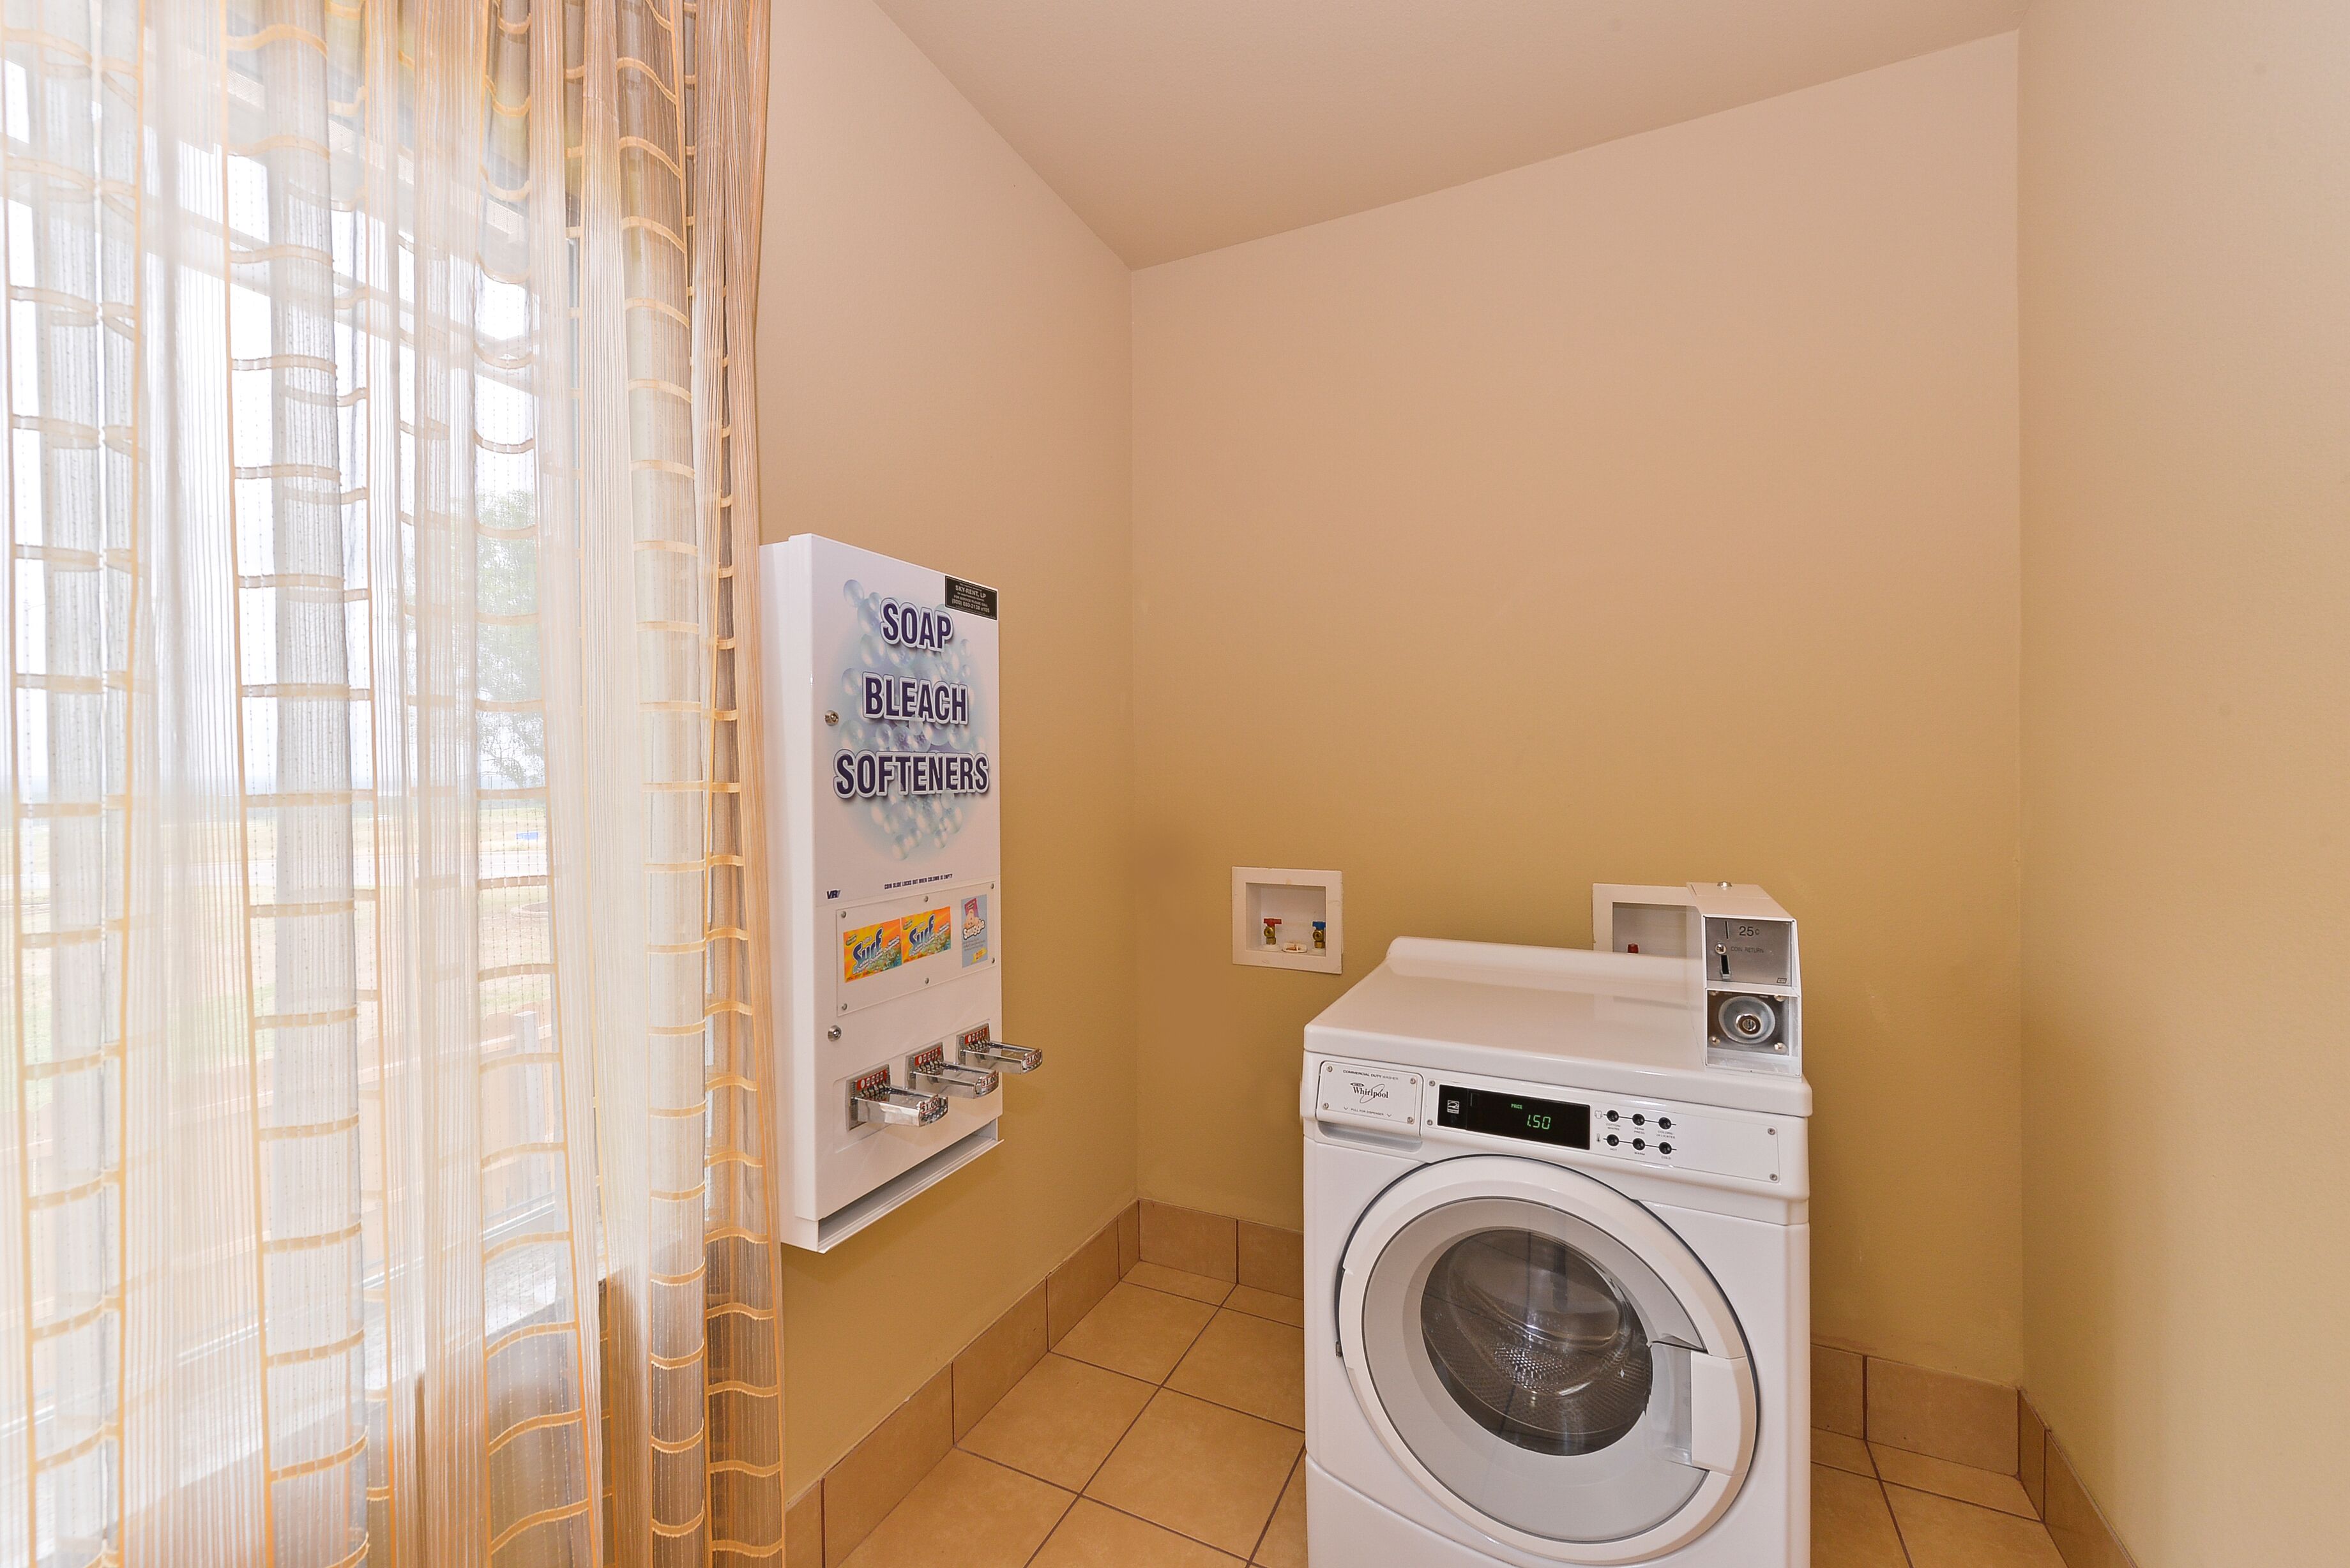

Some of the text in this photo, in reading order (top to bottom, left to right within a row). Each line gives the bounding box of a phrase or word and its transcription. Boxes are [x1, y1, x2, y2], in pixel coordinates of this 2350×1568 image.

[881, 599, 953, 651] SOAP
[862, 672, 968, 724] BLEACH
[834, 750, 989, 798] SOFTENERS
[853, 927, 883, 971] Surf
[909, 914, 935, 955] Surf
[963, 919, 985, 940] Snuggle
[921, 1099, 939, 1112] $1.00
[1353, 1086, 1388, 1099] Whirlpool
[1527, 1114, 1551, 1129] 1.50
